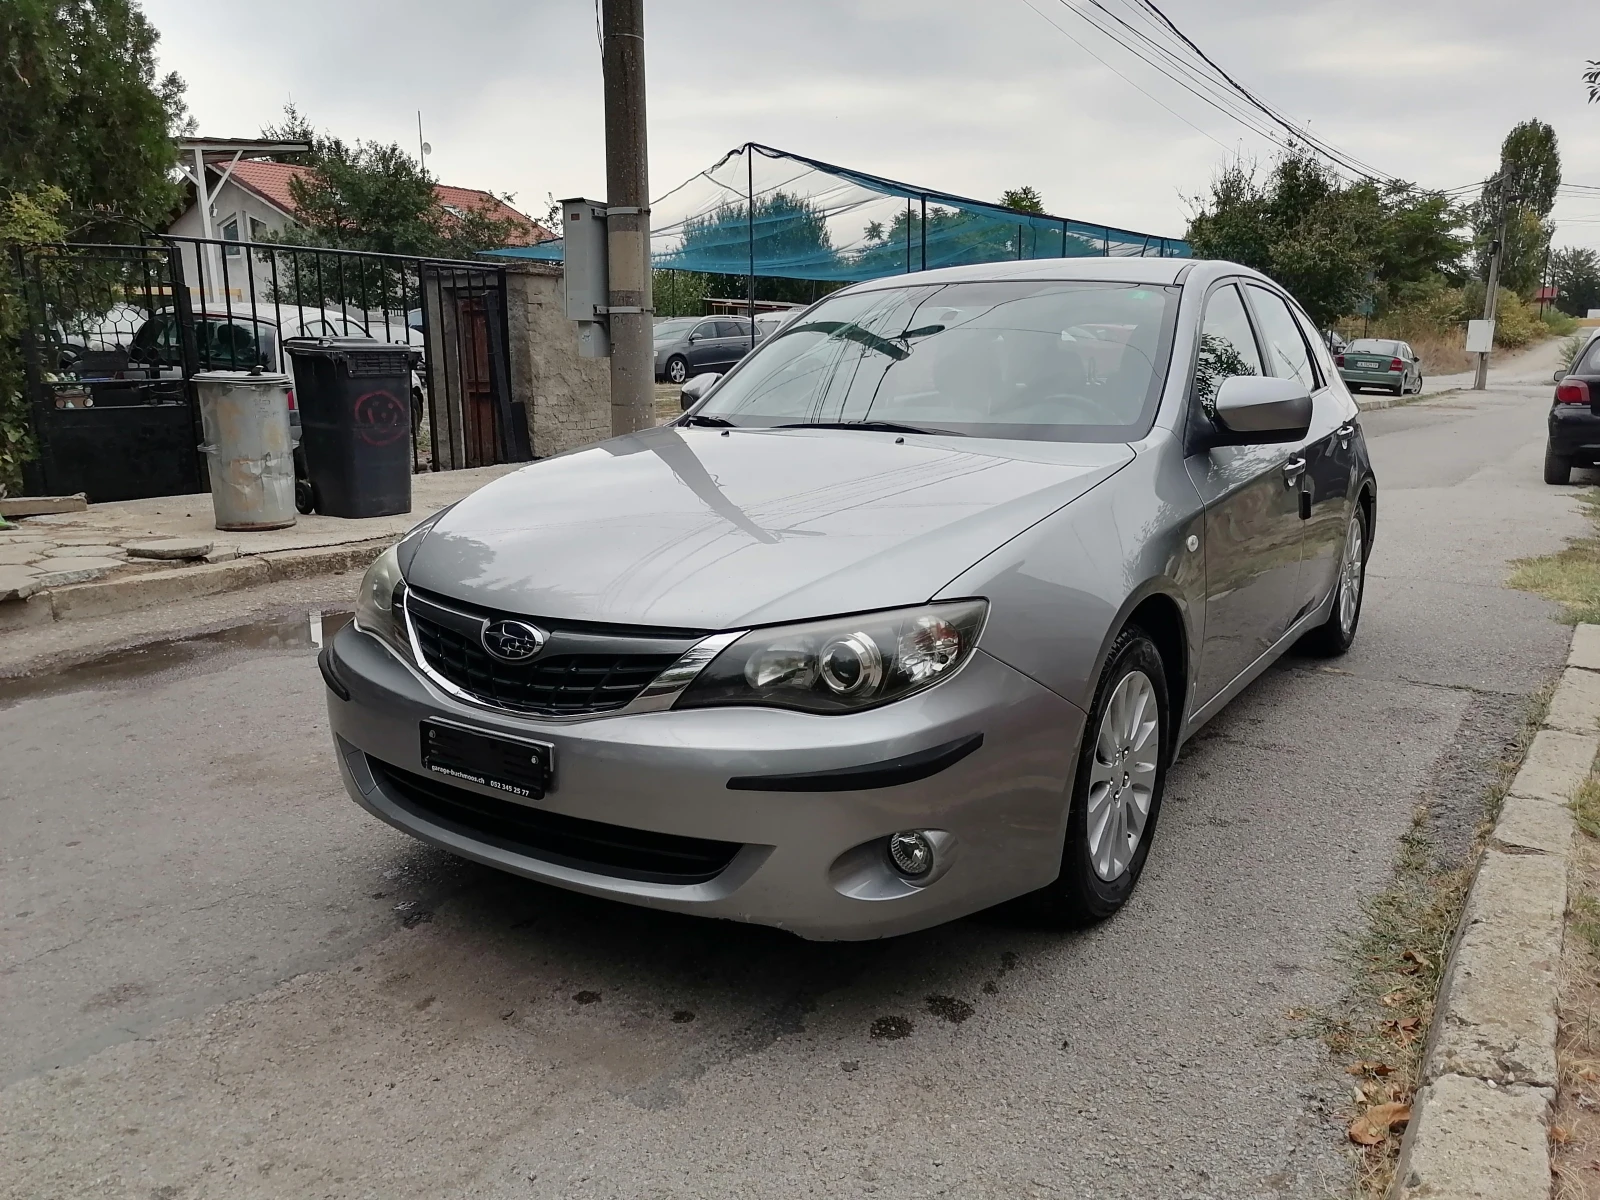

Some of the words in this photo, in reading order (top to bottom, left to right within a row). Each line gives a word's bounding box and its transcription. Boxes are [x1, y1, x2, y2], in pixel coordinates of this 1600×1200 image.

[431, 765, 485, 784] garage-buchmoos.ch
[490, 780, 501, 789] 052
[501, 784, 513, 792] 345
[521, 789, 530, 797] 77
